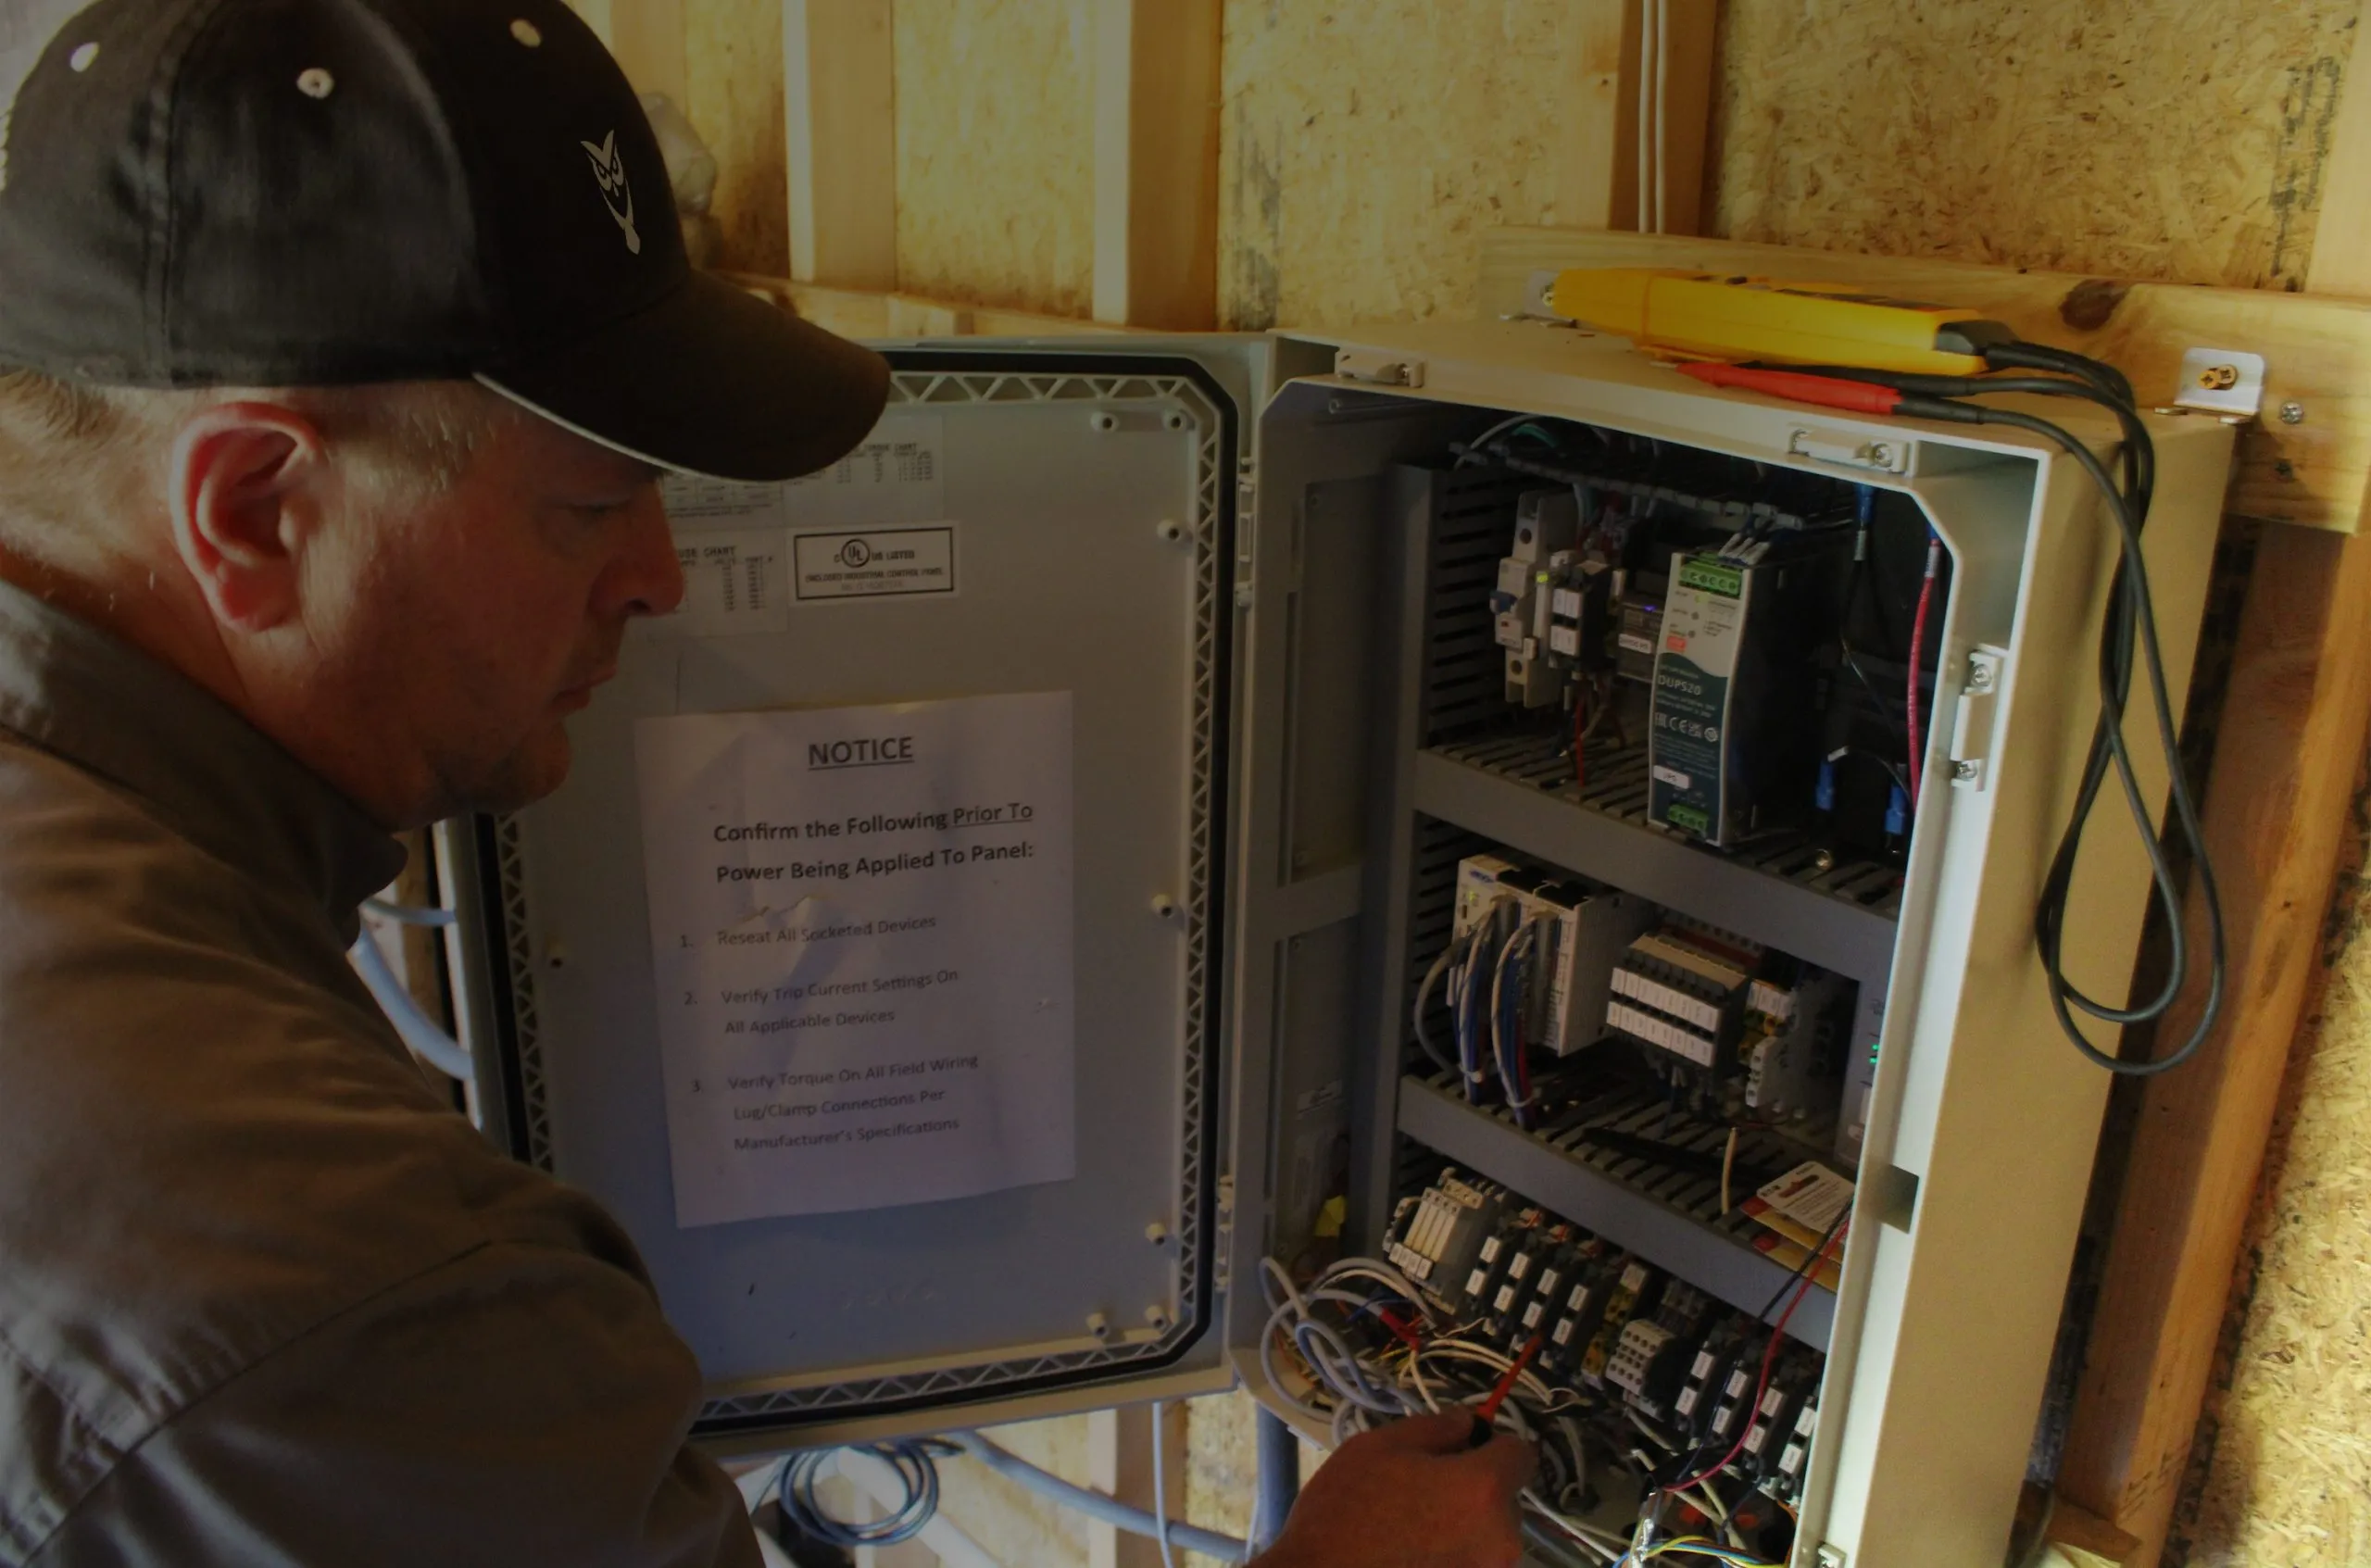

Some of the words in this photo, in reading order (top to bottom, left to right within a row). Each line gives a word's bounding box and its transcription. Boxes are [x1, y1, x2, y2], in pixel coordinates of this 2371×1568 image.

[677, 547, 696, 558] USE
[704, 546, 737, 558] CHART
[1658, 674, 1702, 696] DUPS20
[809, 736, 914, 766] NOTICE
[714, 823, 798, 843] Confirm
[805, 820, 840, 837] the
[847, 810, 947, 835] Following
[952, 805, 1002, 825] Prior
[1007, 802, 1033, 820] To
[717, 863, 784, 883] Power
[791, 860, 849, 880] Being
[855, 852, 934, 877] Applied
[941, 849, 965, 866] To
[972, 842, 1034, 862] Panel:
[681, 934, 694, 948] 1.
[718, 930, 772, 946] Reseat
[776, 927, 797, 942] All
[801, 923, 872, 942] Socketed
[878, 916, 936, 934] Devices
[684, 992, 697, 1005] 2.
[721, 986, 769, 1006] Verify
[773, 985, 804, 1003] Trip
[808, 980, 868, 997] Current
[872, 973, 933, 992] Settings
[936, 970, 958, 984] On
[724, 1019, 746, 1035] All
[749, 1013, 831, 1033] Applicable
[835, 1010, 896, 1026] Devices
[728, 1073, 775, 1091] Verify
[779, 1072, 834, 1087] Torque
[838, 1068, 861, 1082] On
[865, 1065, 885, 1080] All
[890, 1060, 924, 1077] Field
[930, 1054, 979, 1073] Wiring
[734, 1102, 817, 1121] Lug/Clamp
[822, 1094, 916, 1113] Connections
[921, 1089, 946, 1103] Per
[734, 1131, 852, 1150] Manufacturer's
[858, 1119, 960, 1141] Specifications
